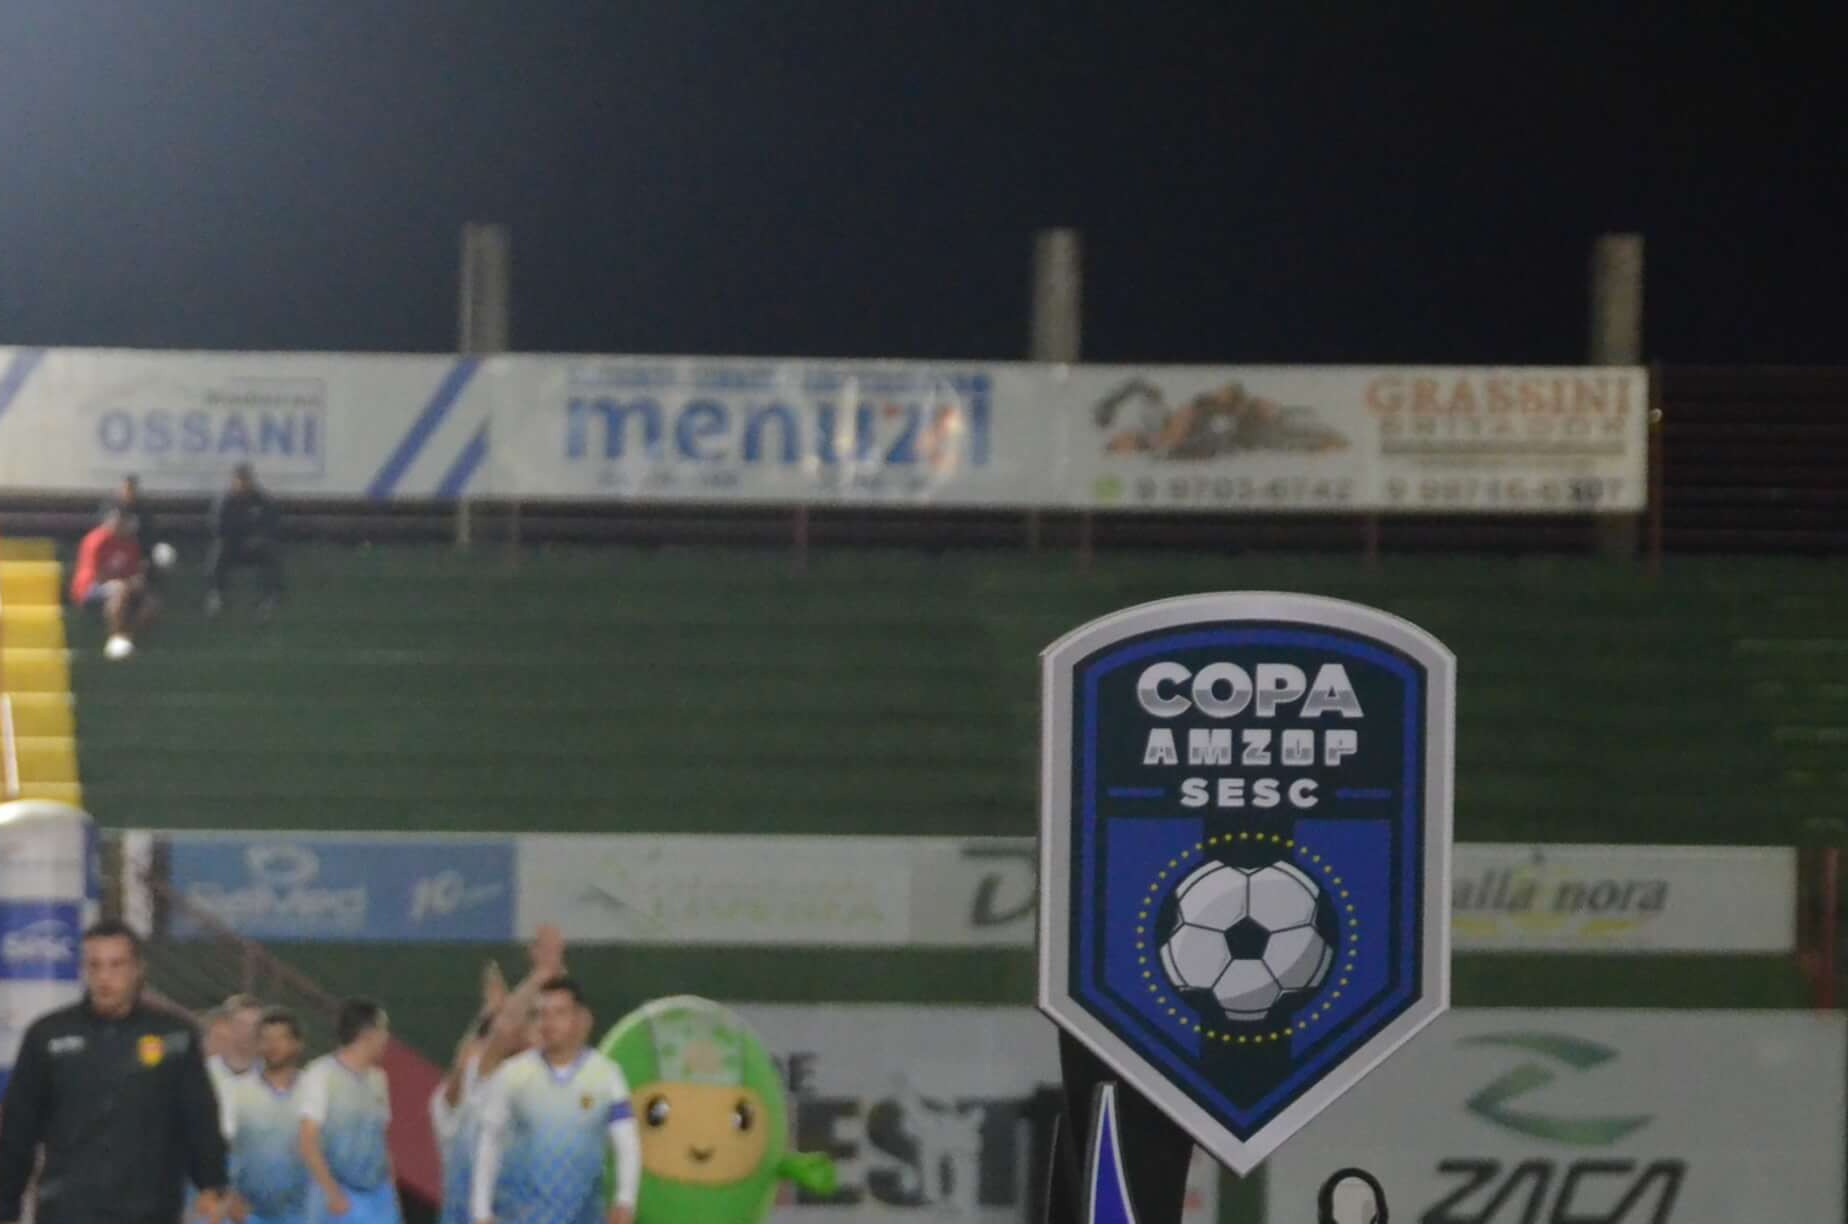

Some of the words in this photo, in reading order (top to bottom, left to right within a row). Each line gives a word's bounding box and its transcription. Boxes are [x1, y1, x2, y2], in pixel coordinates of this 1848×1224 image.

[1364, 376, 1631, 416] GRASSINI
[98, 409, 317, 455] OSSANI
[1137, 662, 1364, 719] COPA
[1143, 728, 1359, 767] AMZOP
[1180, 778, 1320, 808] SESC
[1555, 878, 1669, 913] nora
